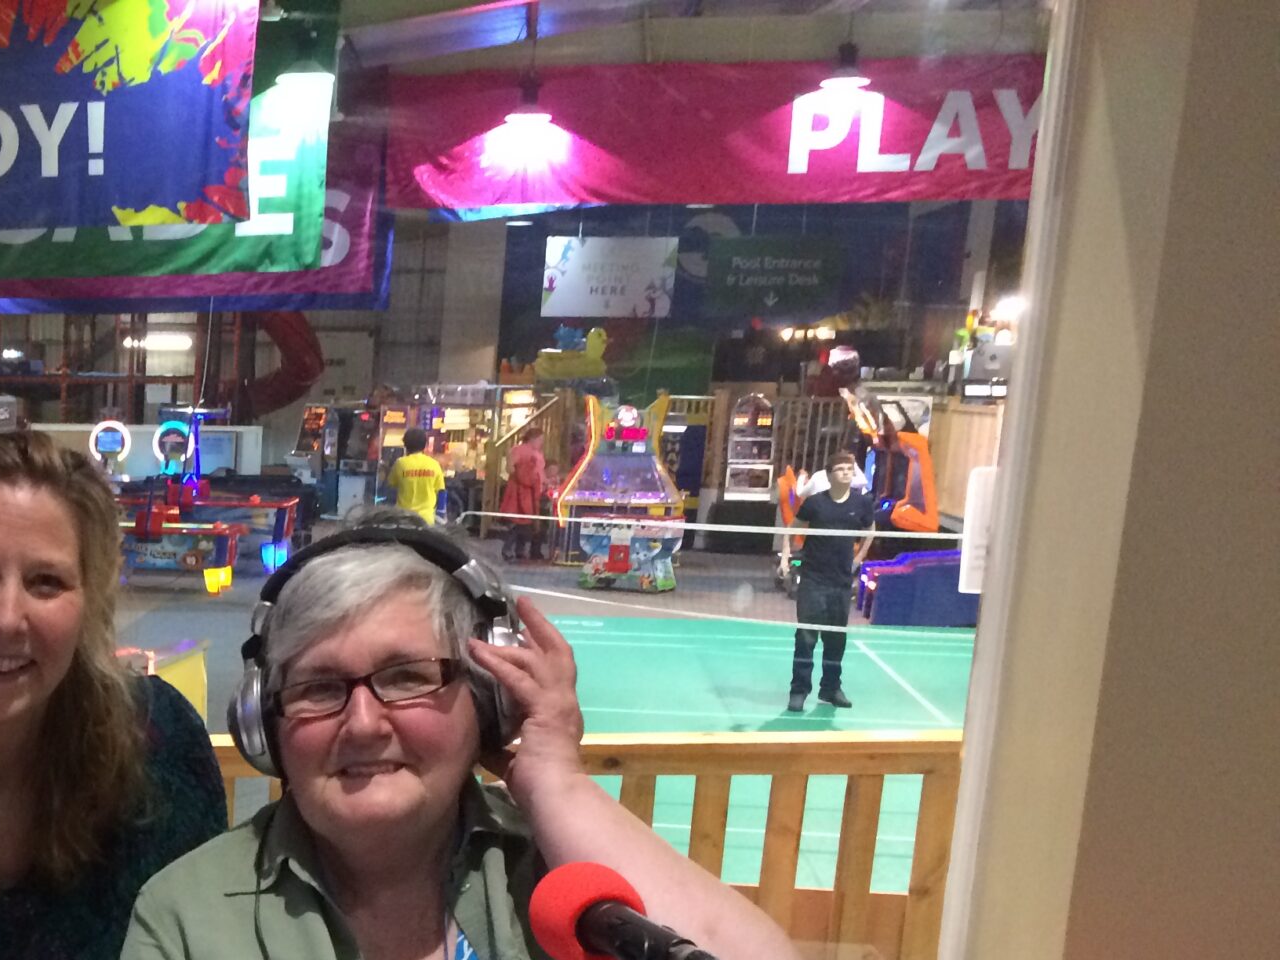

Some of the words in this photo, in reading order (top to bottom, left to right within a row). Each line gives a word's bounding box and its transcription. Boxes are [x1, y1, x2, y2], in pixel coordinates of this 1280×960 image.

[787, 89, 1042, 174] PLAY
[582, 262, 640, 273] MEETING
[732, 256, 760, 270] Pool
[763, 257, 822, 271] Entrance
[586, 274, 631, 284] POINT
[738, 273, 785, 286] Leisure
[788, 274, 819, 286] Desk
[589, 285, 626, 296] HERE
